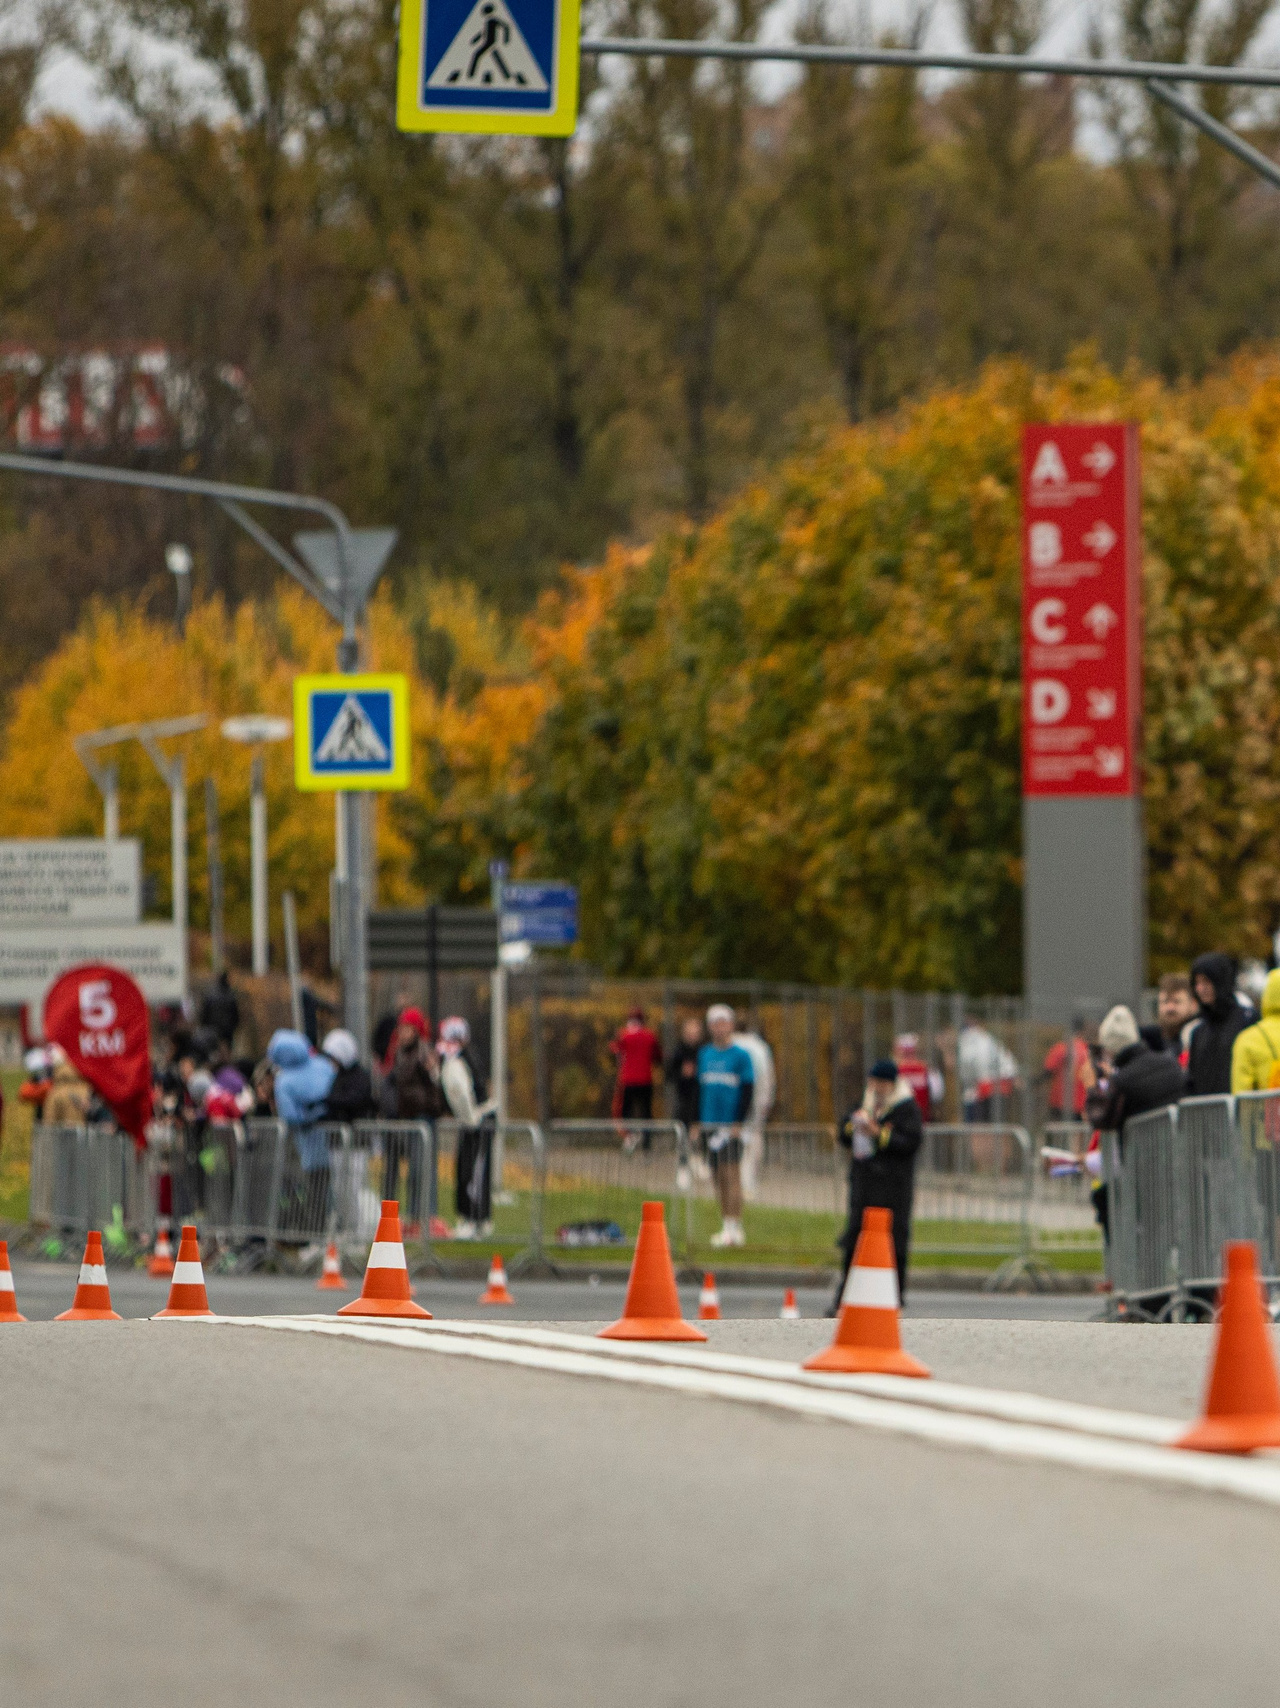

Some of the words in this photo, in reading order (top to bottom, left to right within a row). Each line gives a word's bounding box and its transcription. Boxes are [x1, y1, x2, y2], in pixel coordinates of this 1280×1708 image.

[1031, 441, 1067, 483] A
[1029, 522, 1061, 564] B
[1030, 598, 1066, 644] C
[1031, 679, 1070, 724] D
[78, 979, 117, 1030] 5
